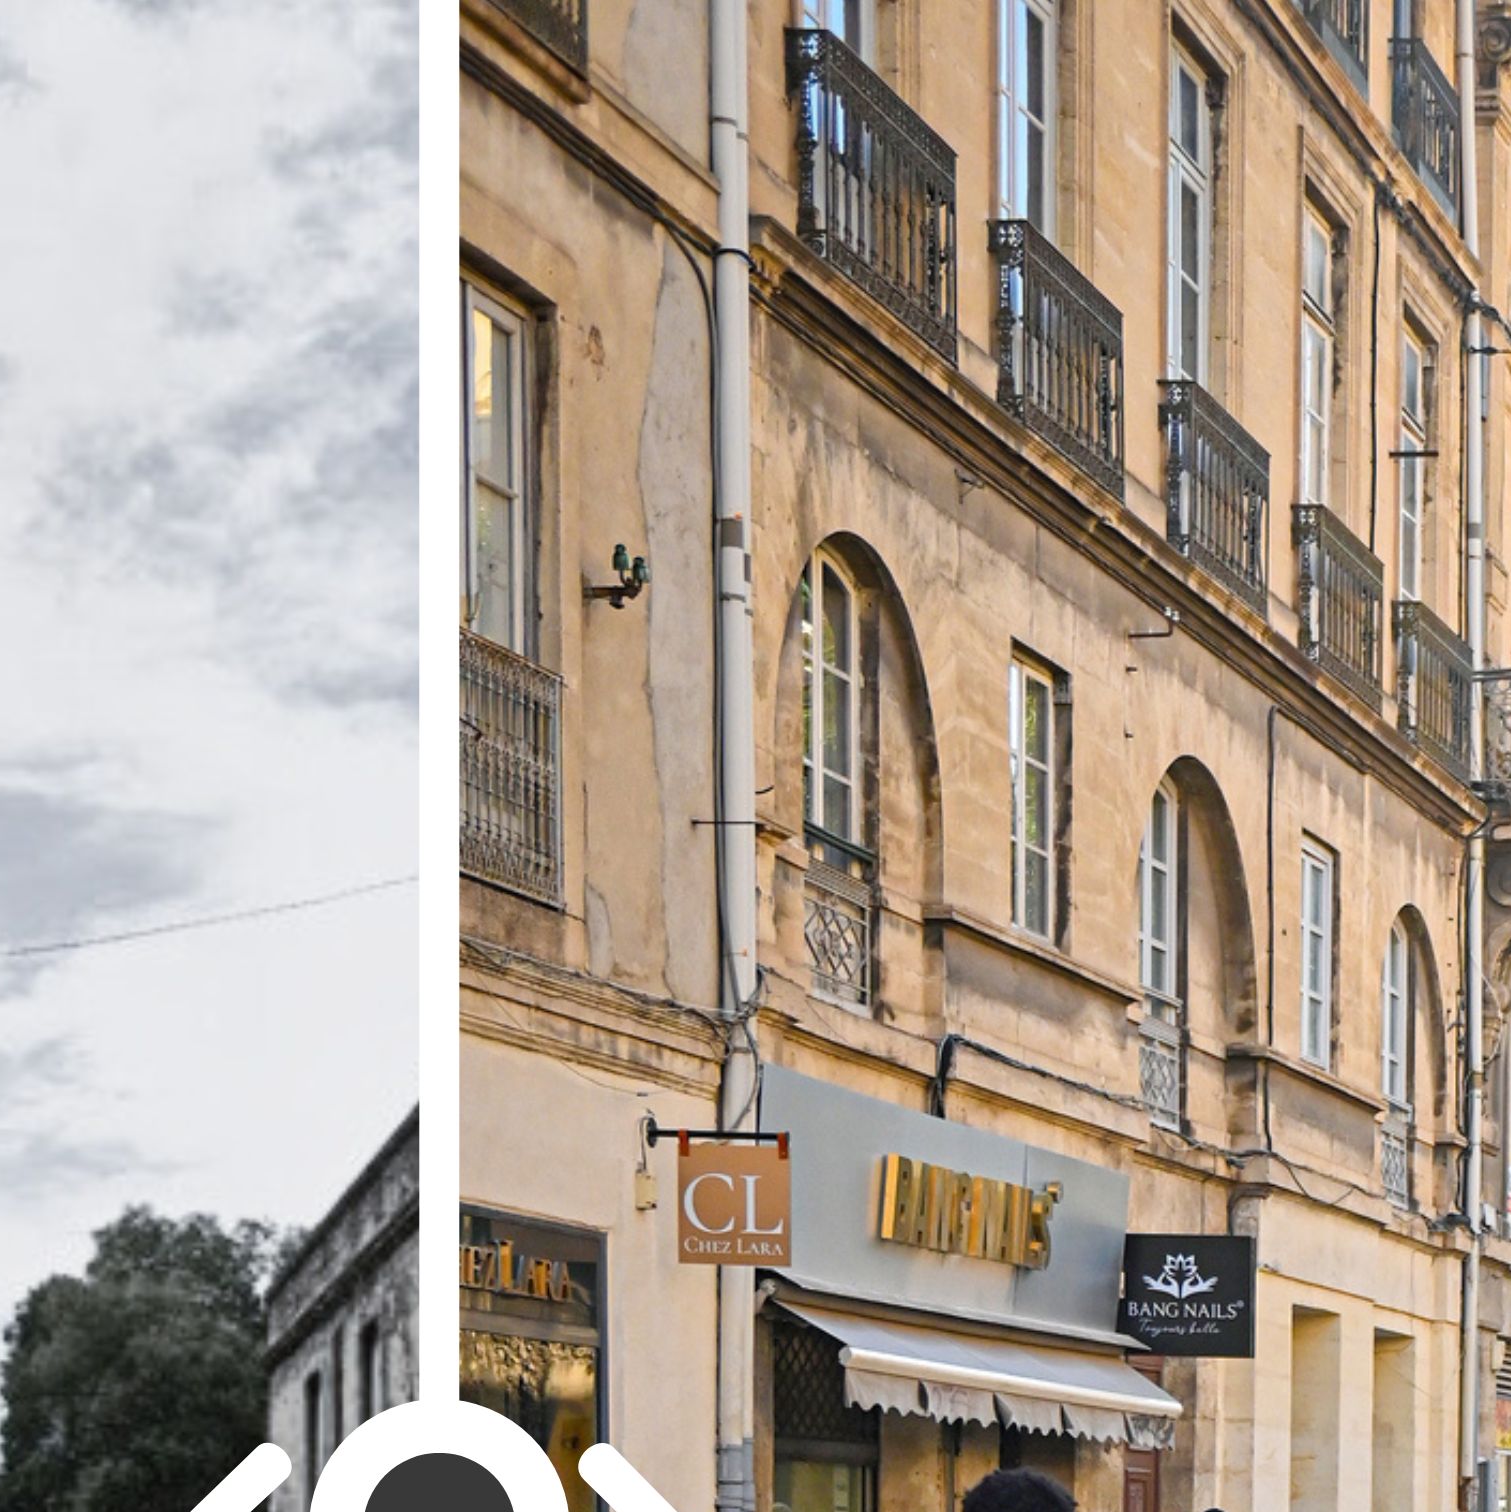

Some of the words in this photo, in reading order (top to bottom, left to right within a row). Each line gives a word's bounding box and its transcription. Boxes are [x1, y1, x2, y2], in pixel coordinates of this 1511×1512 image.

[683, 1173, 784, 1235] CL
[737, 1238, 784, 1257] LARA
[1128, 1301, 1178, 1319] BANG
[1183, 1302, 1238, 1320] NAILS
